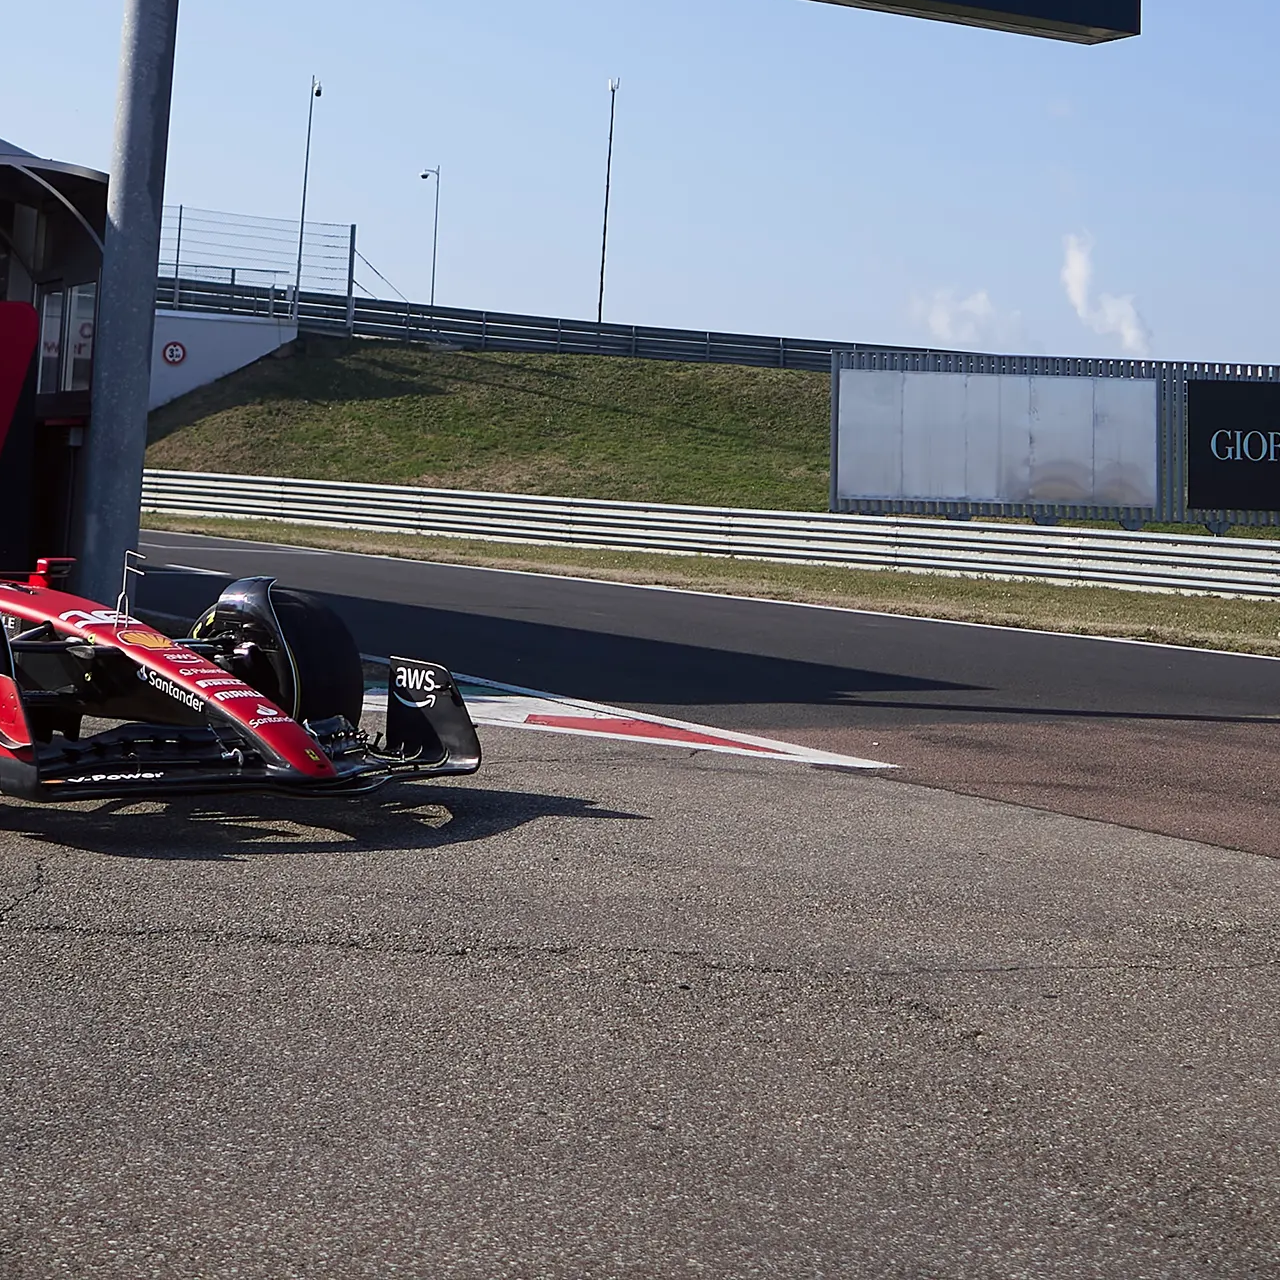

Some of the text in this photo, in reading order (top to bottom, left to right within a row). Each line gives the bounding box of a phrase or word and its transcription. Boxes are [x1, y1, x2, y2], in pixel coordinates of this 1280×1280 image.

[148, 671, 205, 712] Santander
[395, 666, 436, 692] aws
[67, 771, 164, 784] V-Power
